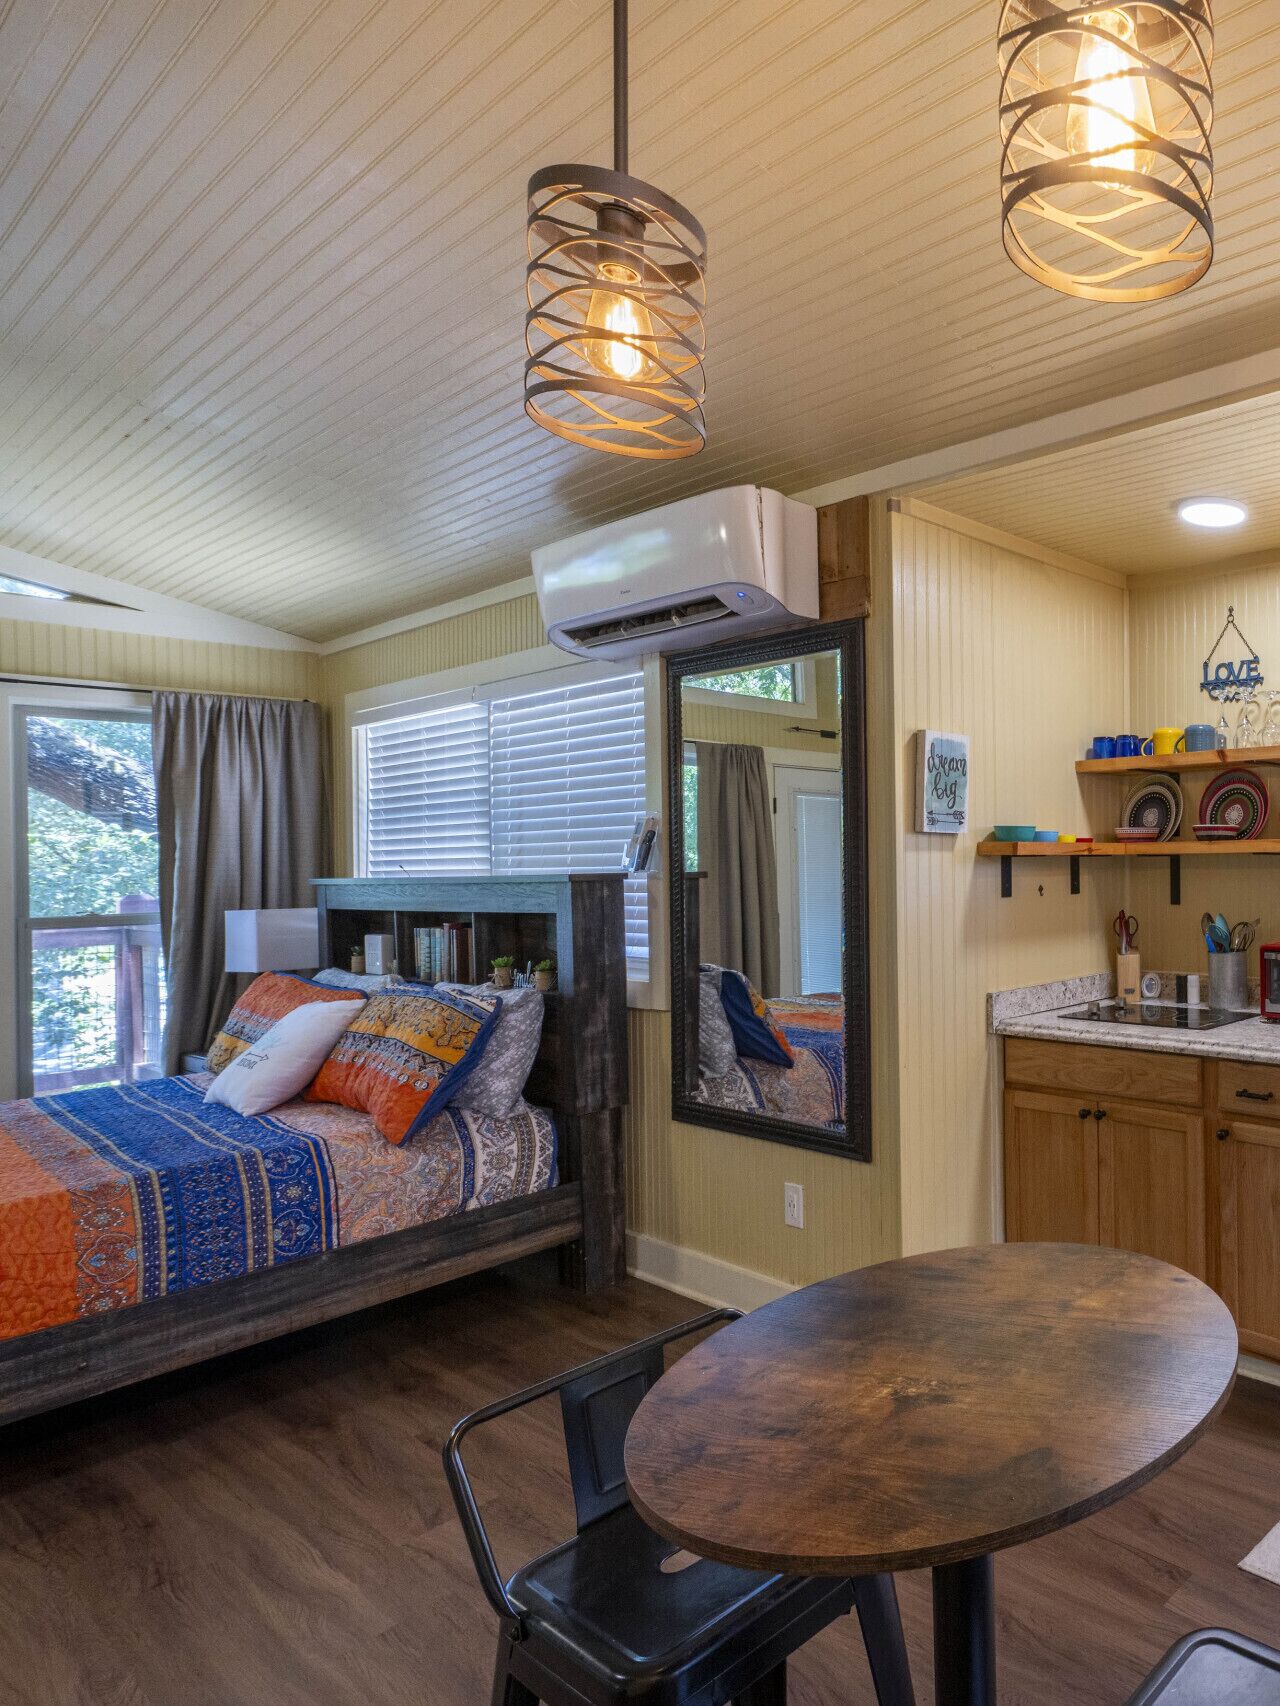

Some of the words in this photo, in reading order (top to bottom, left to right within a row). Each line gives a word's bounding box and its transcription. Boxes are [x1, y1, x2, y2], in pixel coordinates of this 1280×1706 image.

[1203, 656, 1260, 682] LOVE
[927, 742, 967, 777] dream
[931, 771, 963, 809] big
